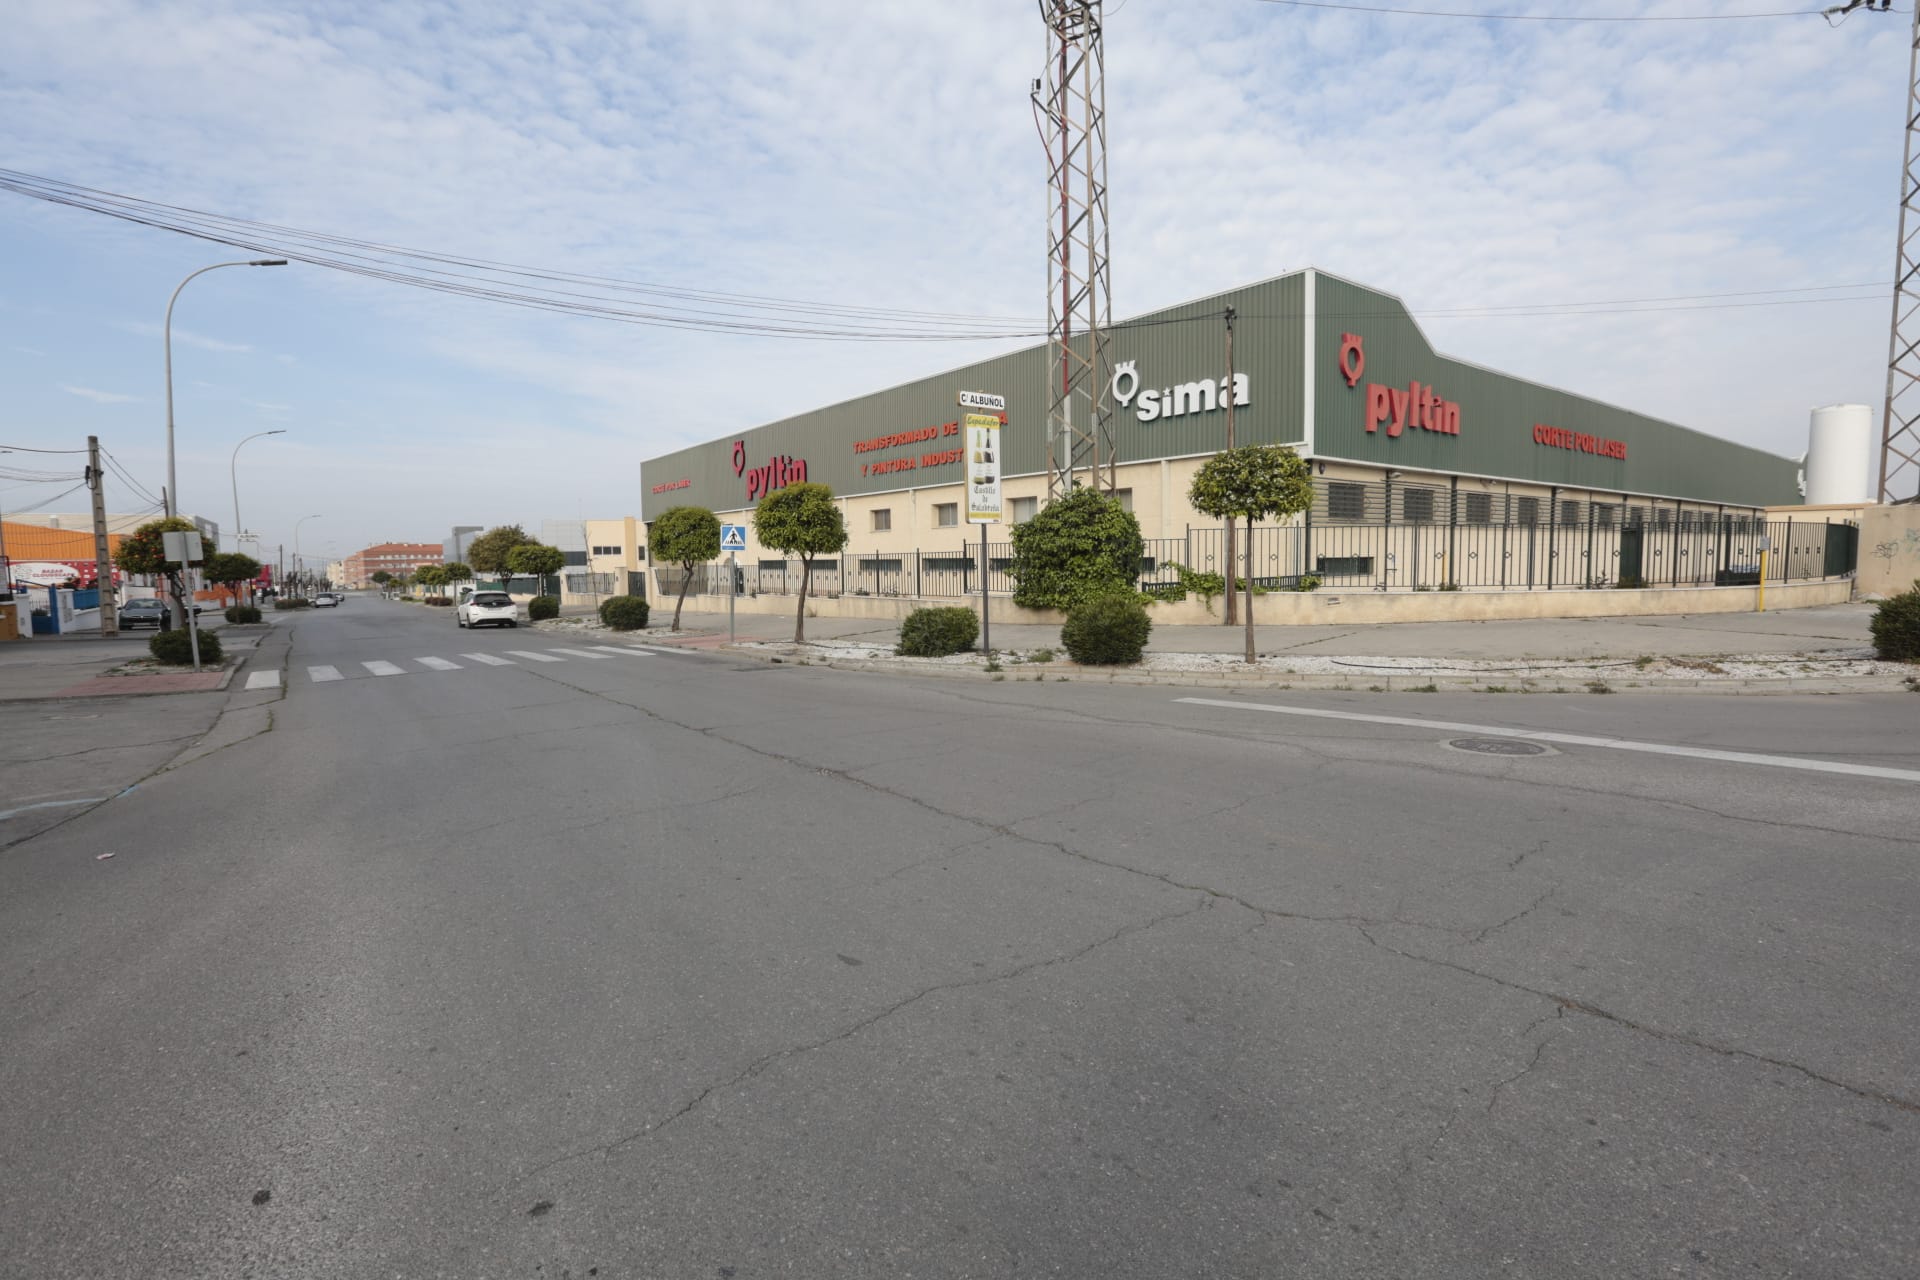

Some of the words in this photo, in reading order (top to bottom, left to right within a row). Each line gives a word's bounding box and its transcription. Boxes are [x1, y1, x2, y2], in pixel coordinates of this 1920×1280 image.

[970, 394, 1004, 408] ALBUÑOL
[1136, 372, 1250, 422] sima
[1366, 380, 1460, 438] pyltin
[853, 425, 938, 454] TRANSFORMADO
[943, 421, 958, 437] DE
[1533, 423, 1573, 451] CORTE
[1573, 431, 1595, 454] POR
[1596, 437, 1627, 460] LASER
[746, 453, 807, 501] pyltin
[861, 464, 868, 477] Y
[871, 457, 916, 475] PINTURA
[921, 448, 964, 467] INDUST
